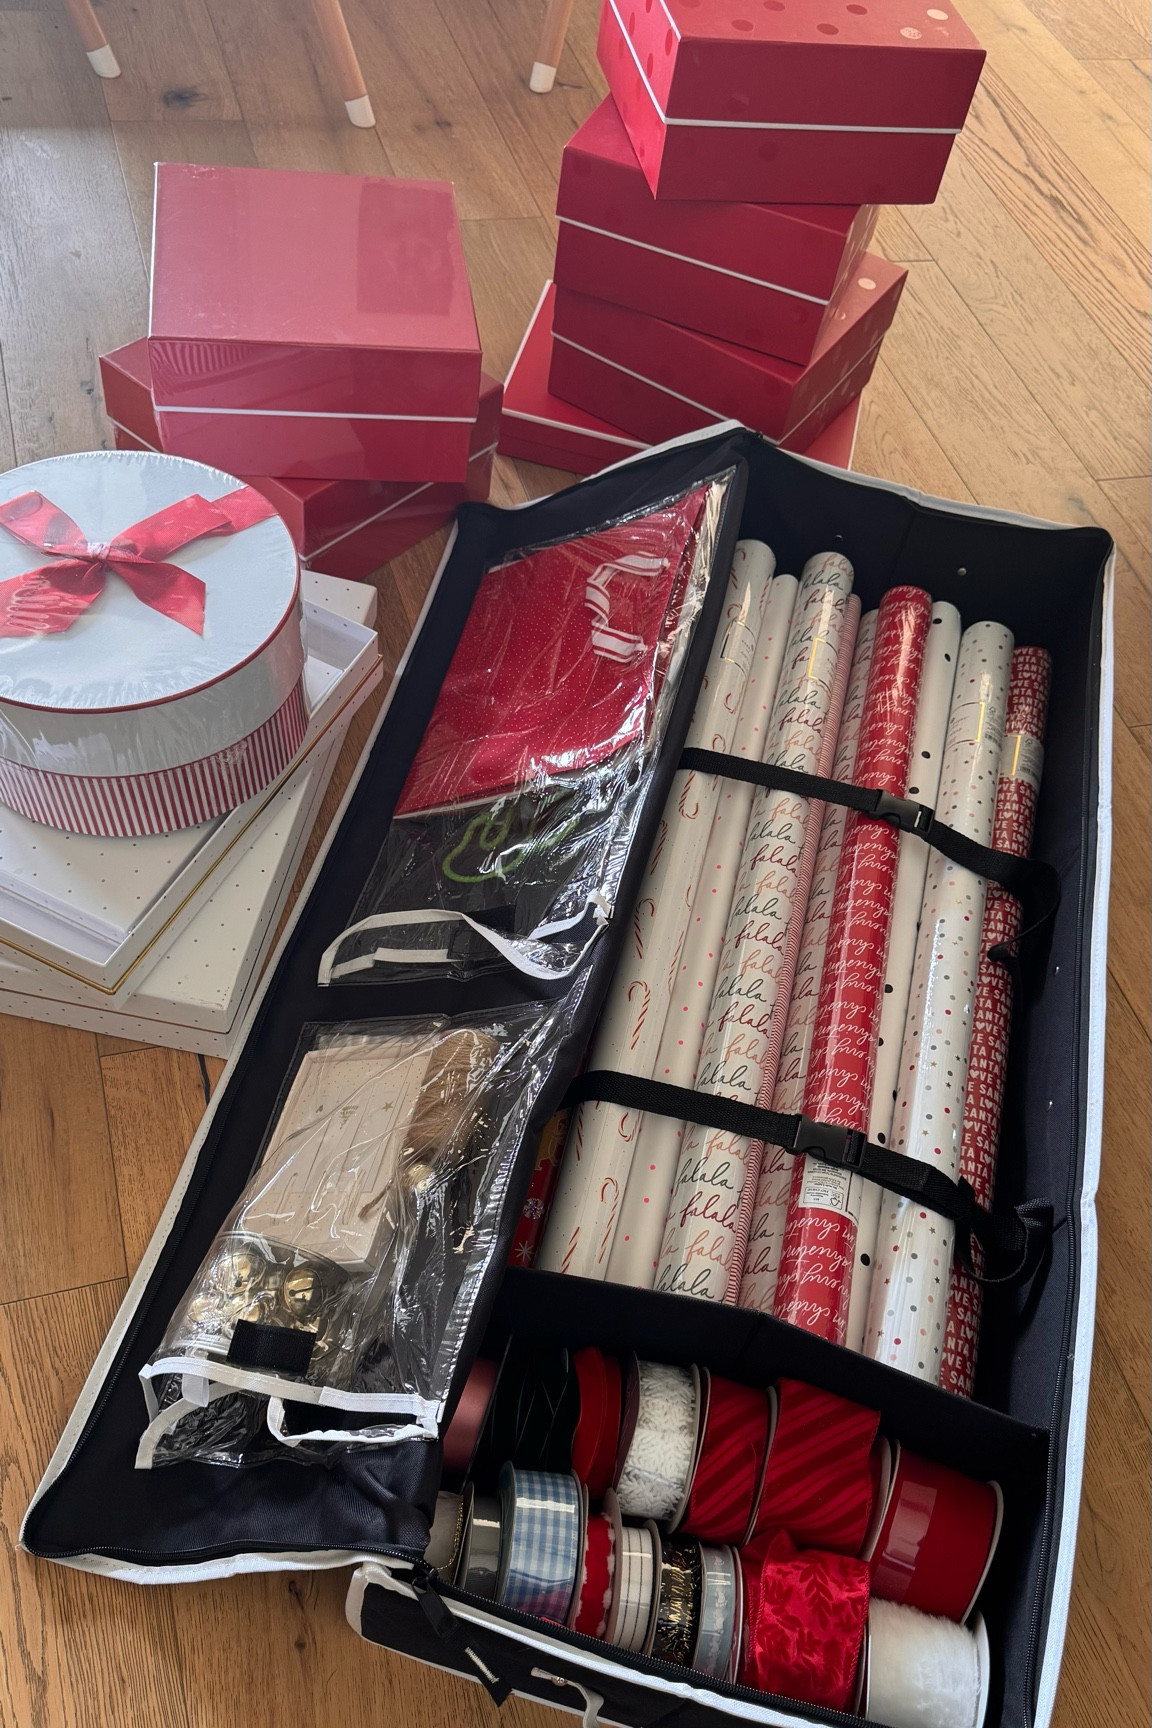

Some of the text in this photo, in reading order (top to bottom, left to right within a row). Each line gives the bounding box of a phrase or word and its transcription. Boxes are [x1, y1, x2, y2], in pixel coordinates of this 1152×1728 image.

[977, 1010, 1004, 1027] ANTA
[971, 1057, 999, 1075] ANTA
[959, 1160, 988, 1179] ANTA
[951, 1275, 979, 1297] ANTA
